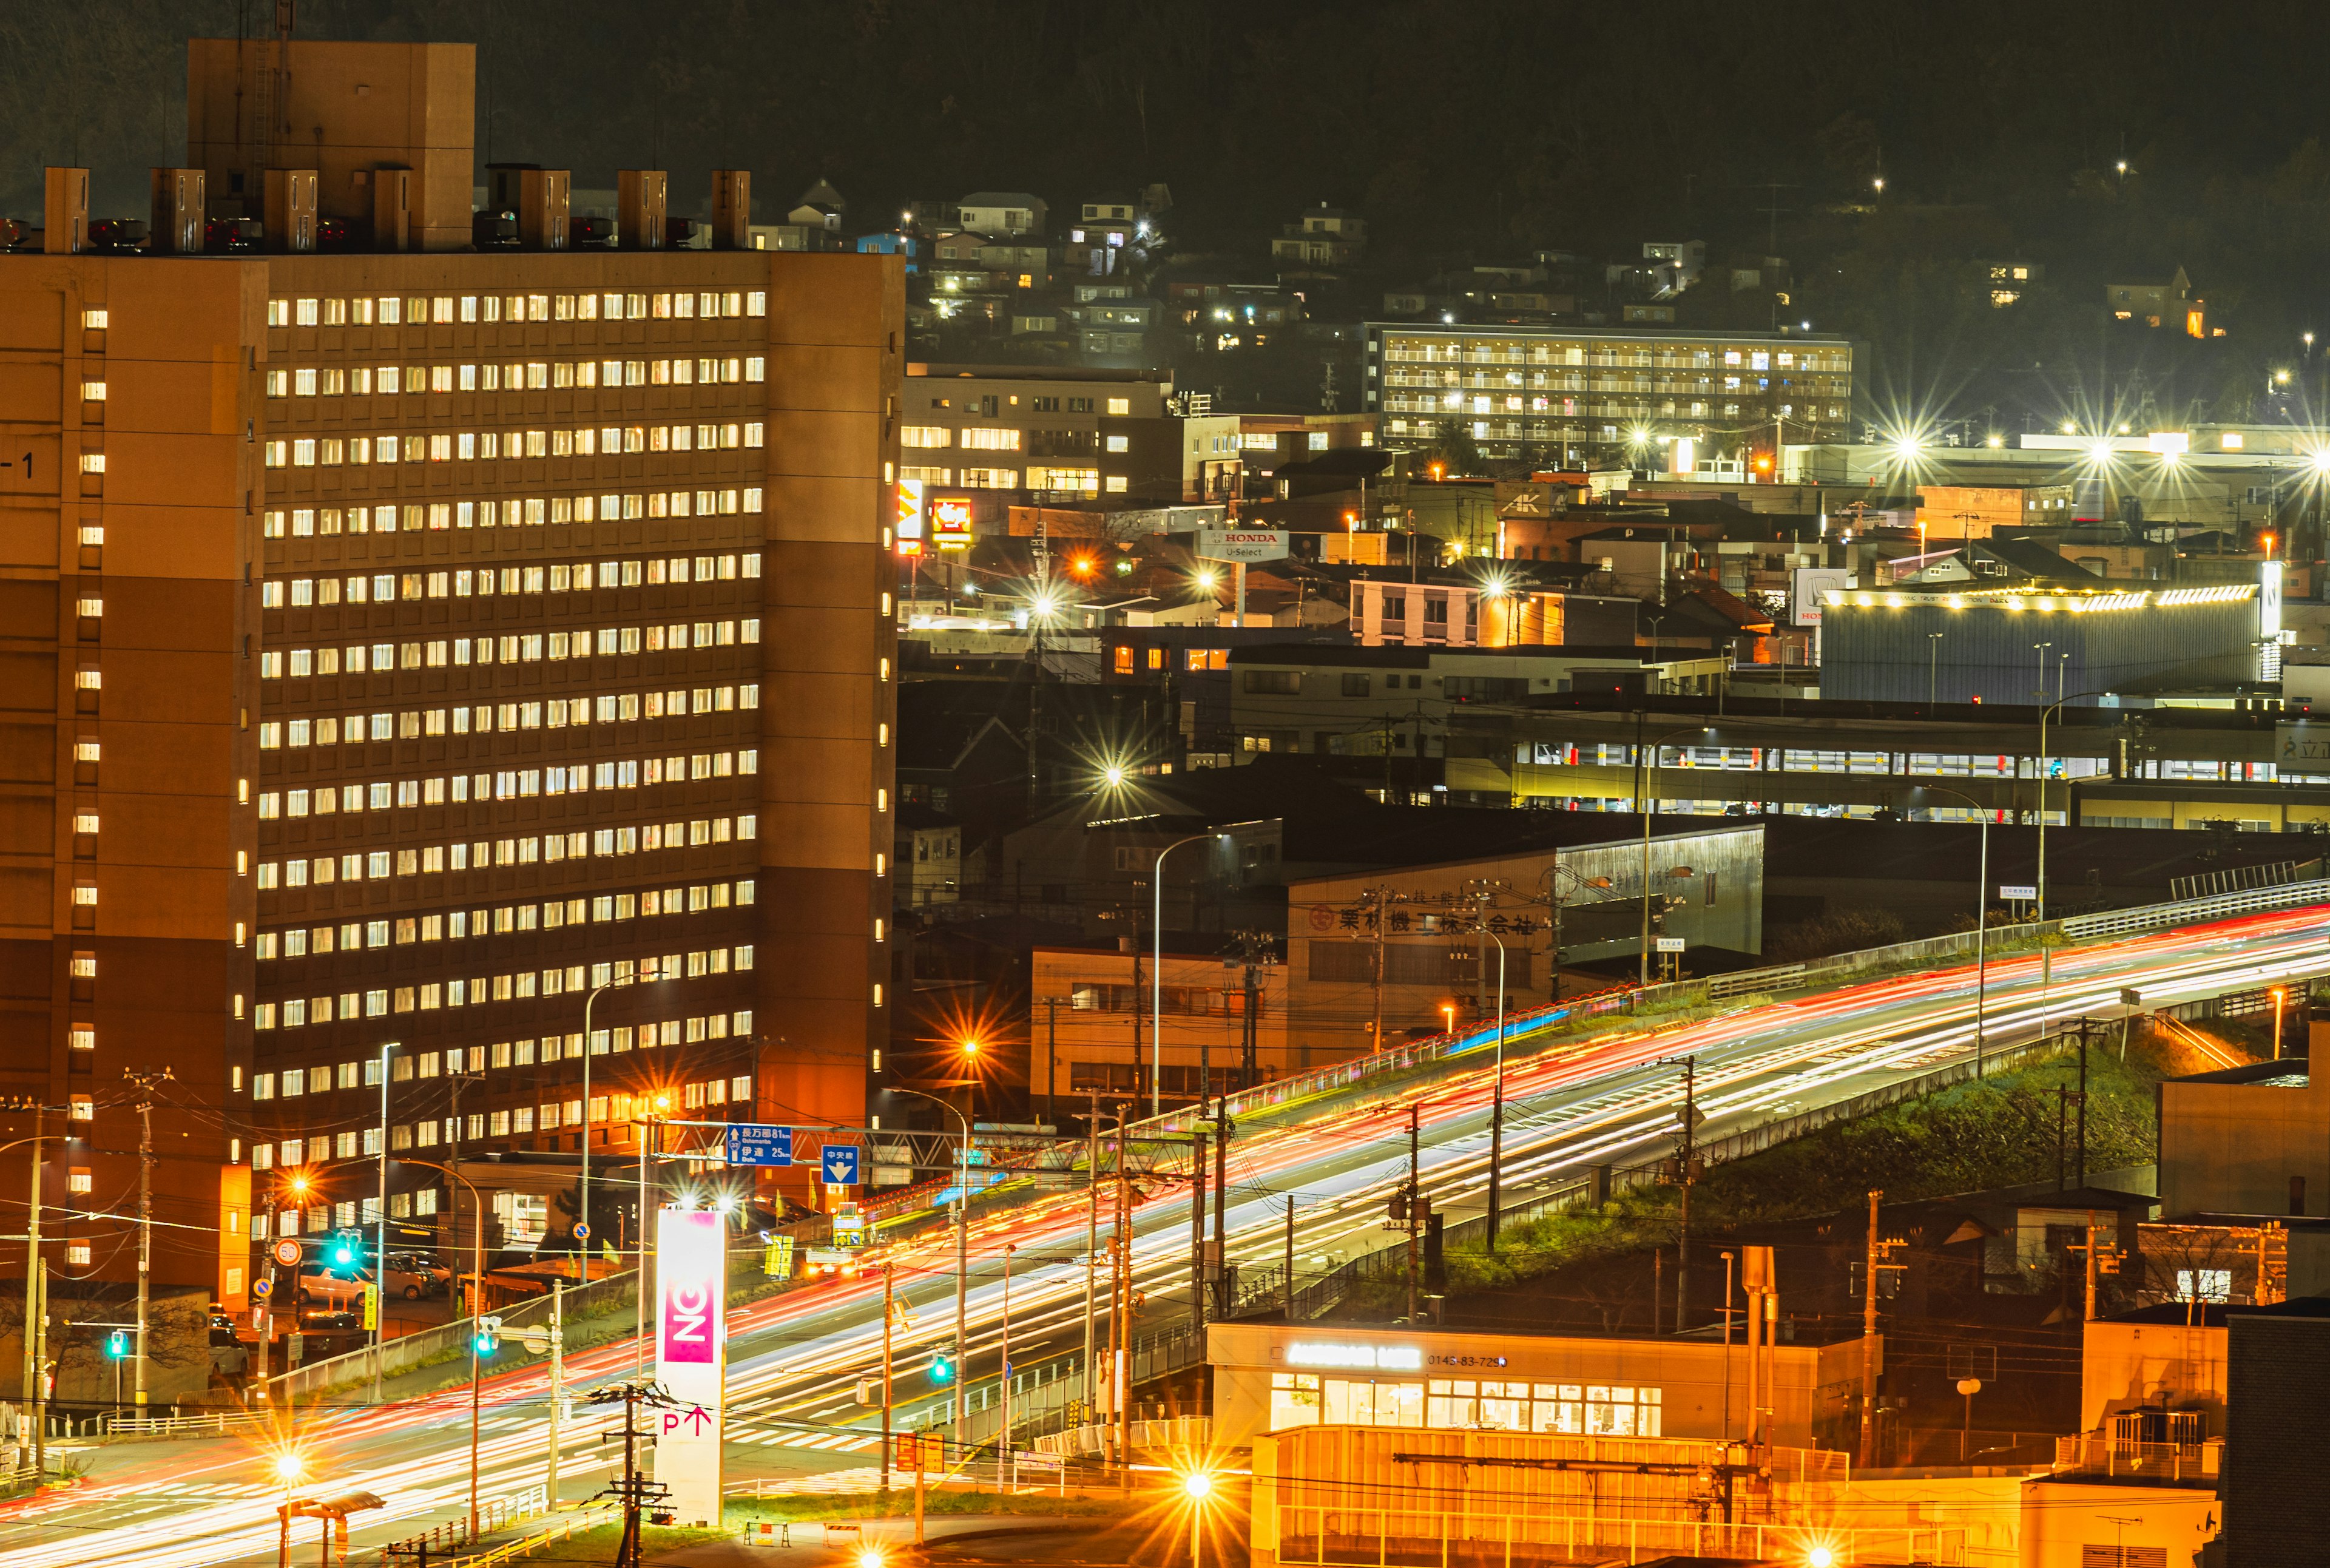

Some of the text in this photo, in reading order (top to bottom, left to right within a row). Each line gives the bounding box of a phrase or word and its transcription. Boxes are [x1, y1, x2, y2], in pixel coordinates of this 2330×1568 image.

[1501, 494, 1540, 513] AK
[742, 1127, 771, 1138] 長万部
[827, 1151, 854, 1160] 中央線
[282, 1246, 295, 1258] 50
[664, 1414, 679, 1436] P
